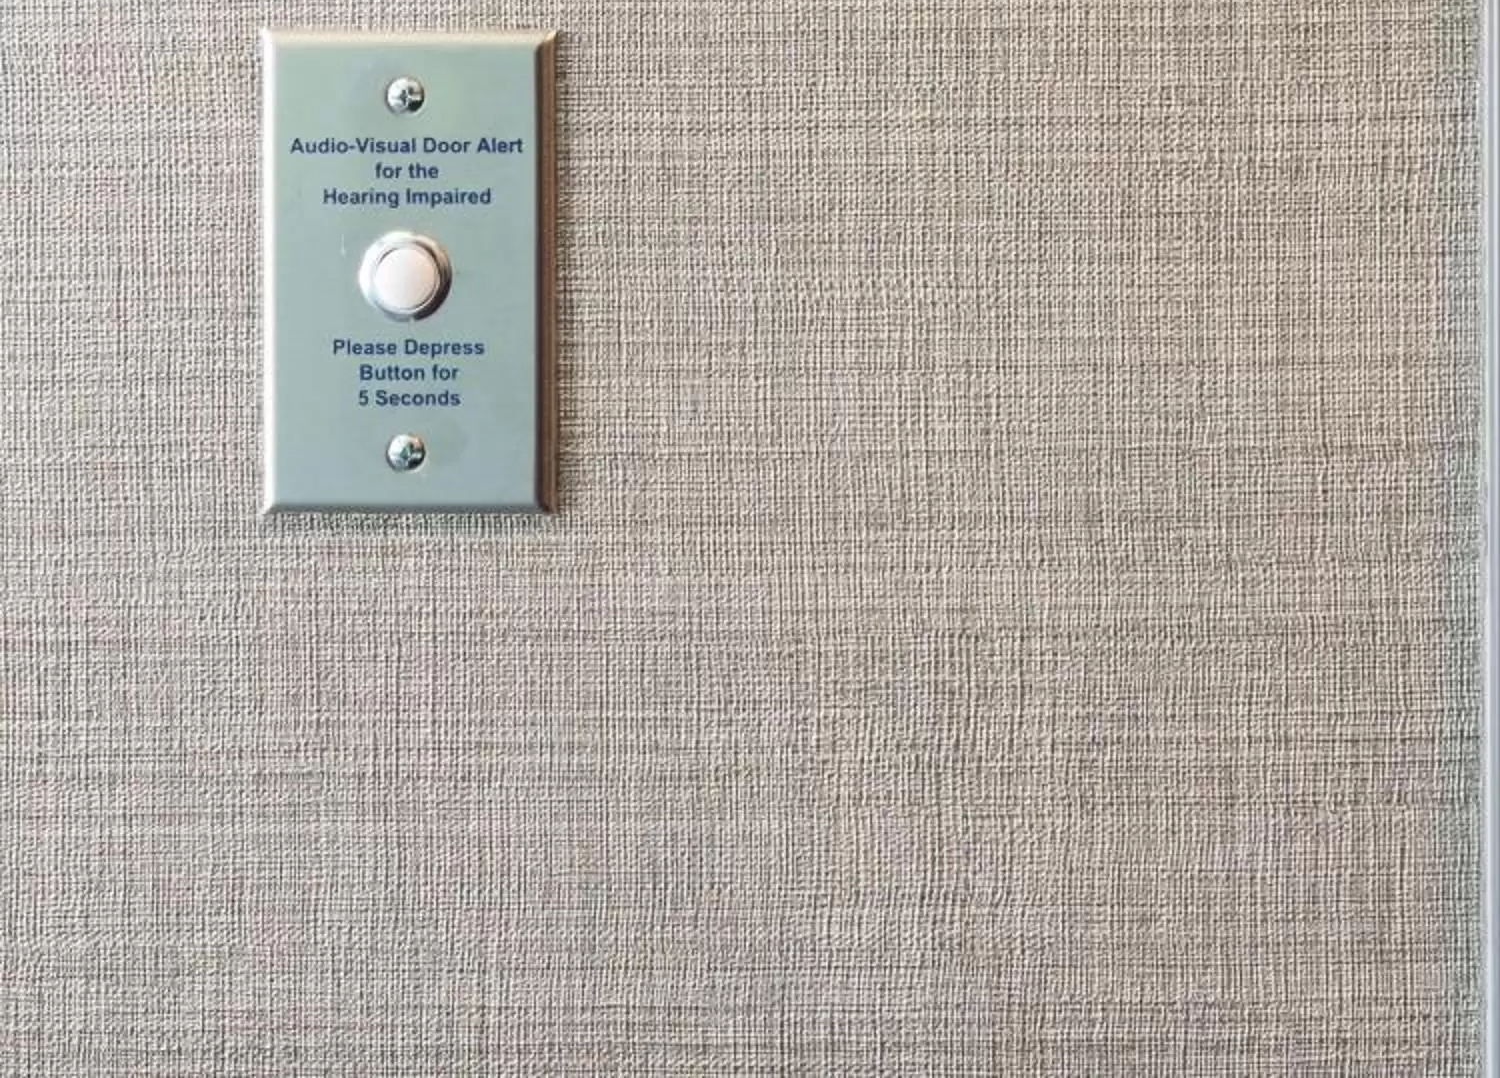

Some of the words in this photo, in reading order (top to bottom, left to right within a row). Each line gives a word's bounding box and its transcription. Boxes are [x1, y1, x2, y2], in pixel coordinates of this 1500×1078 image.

[290, 137, 417, 155] Audio-Visual
[422, 136, 472, 154] Door
[476, 137, 524, 155] Alert
[374, 161, 403, 179] for
[407, 162, 439, 180] the
[323, 187, 400, 209] Hearing
[405, 187, 492, 209] Impaired
[332, 338, 398, 356] Please
[403, 338, 486, 360] Depress
[359, 363, 426, 382] Button
[431, 363, 460, 382] for
[358, 389, 370, 407] 5
[375, 389, 462, 407] Seconds
